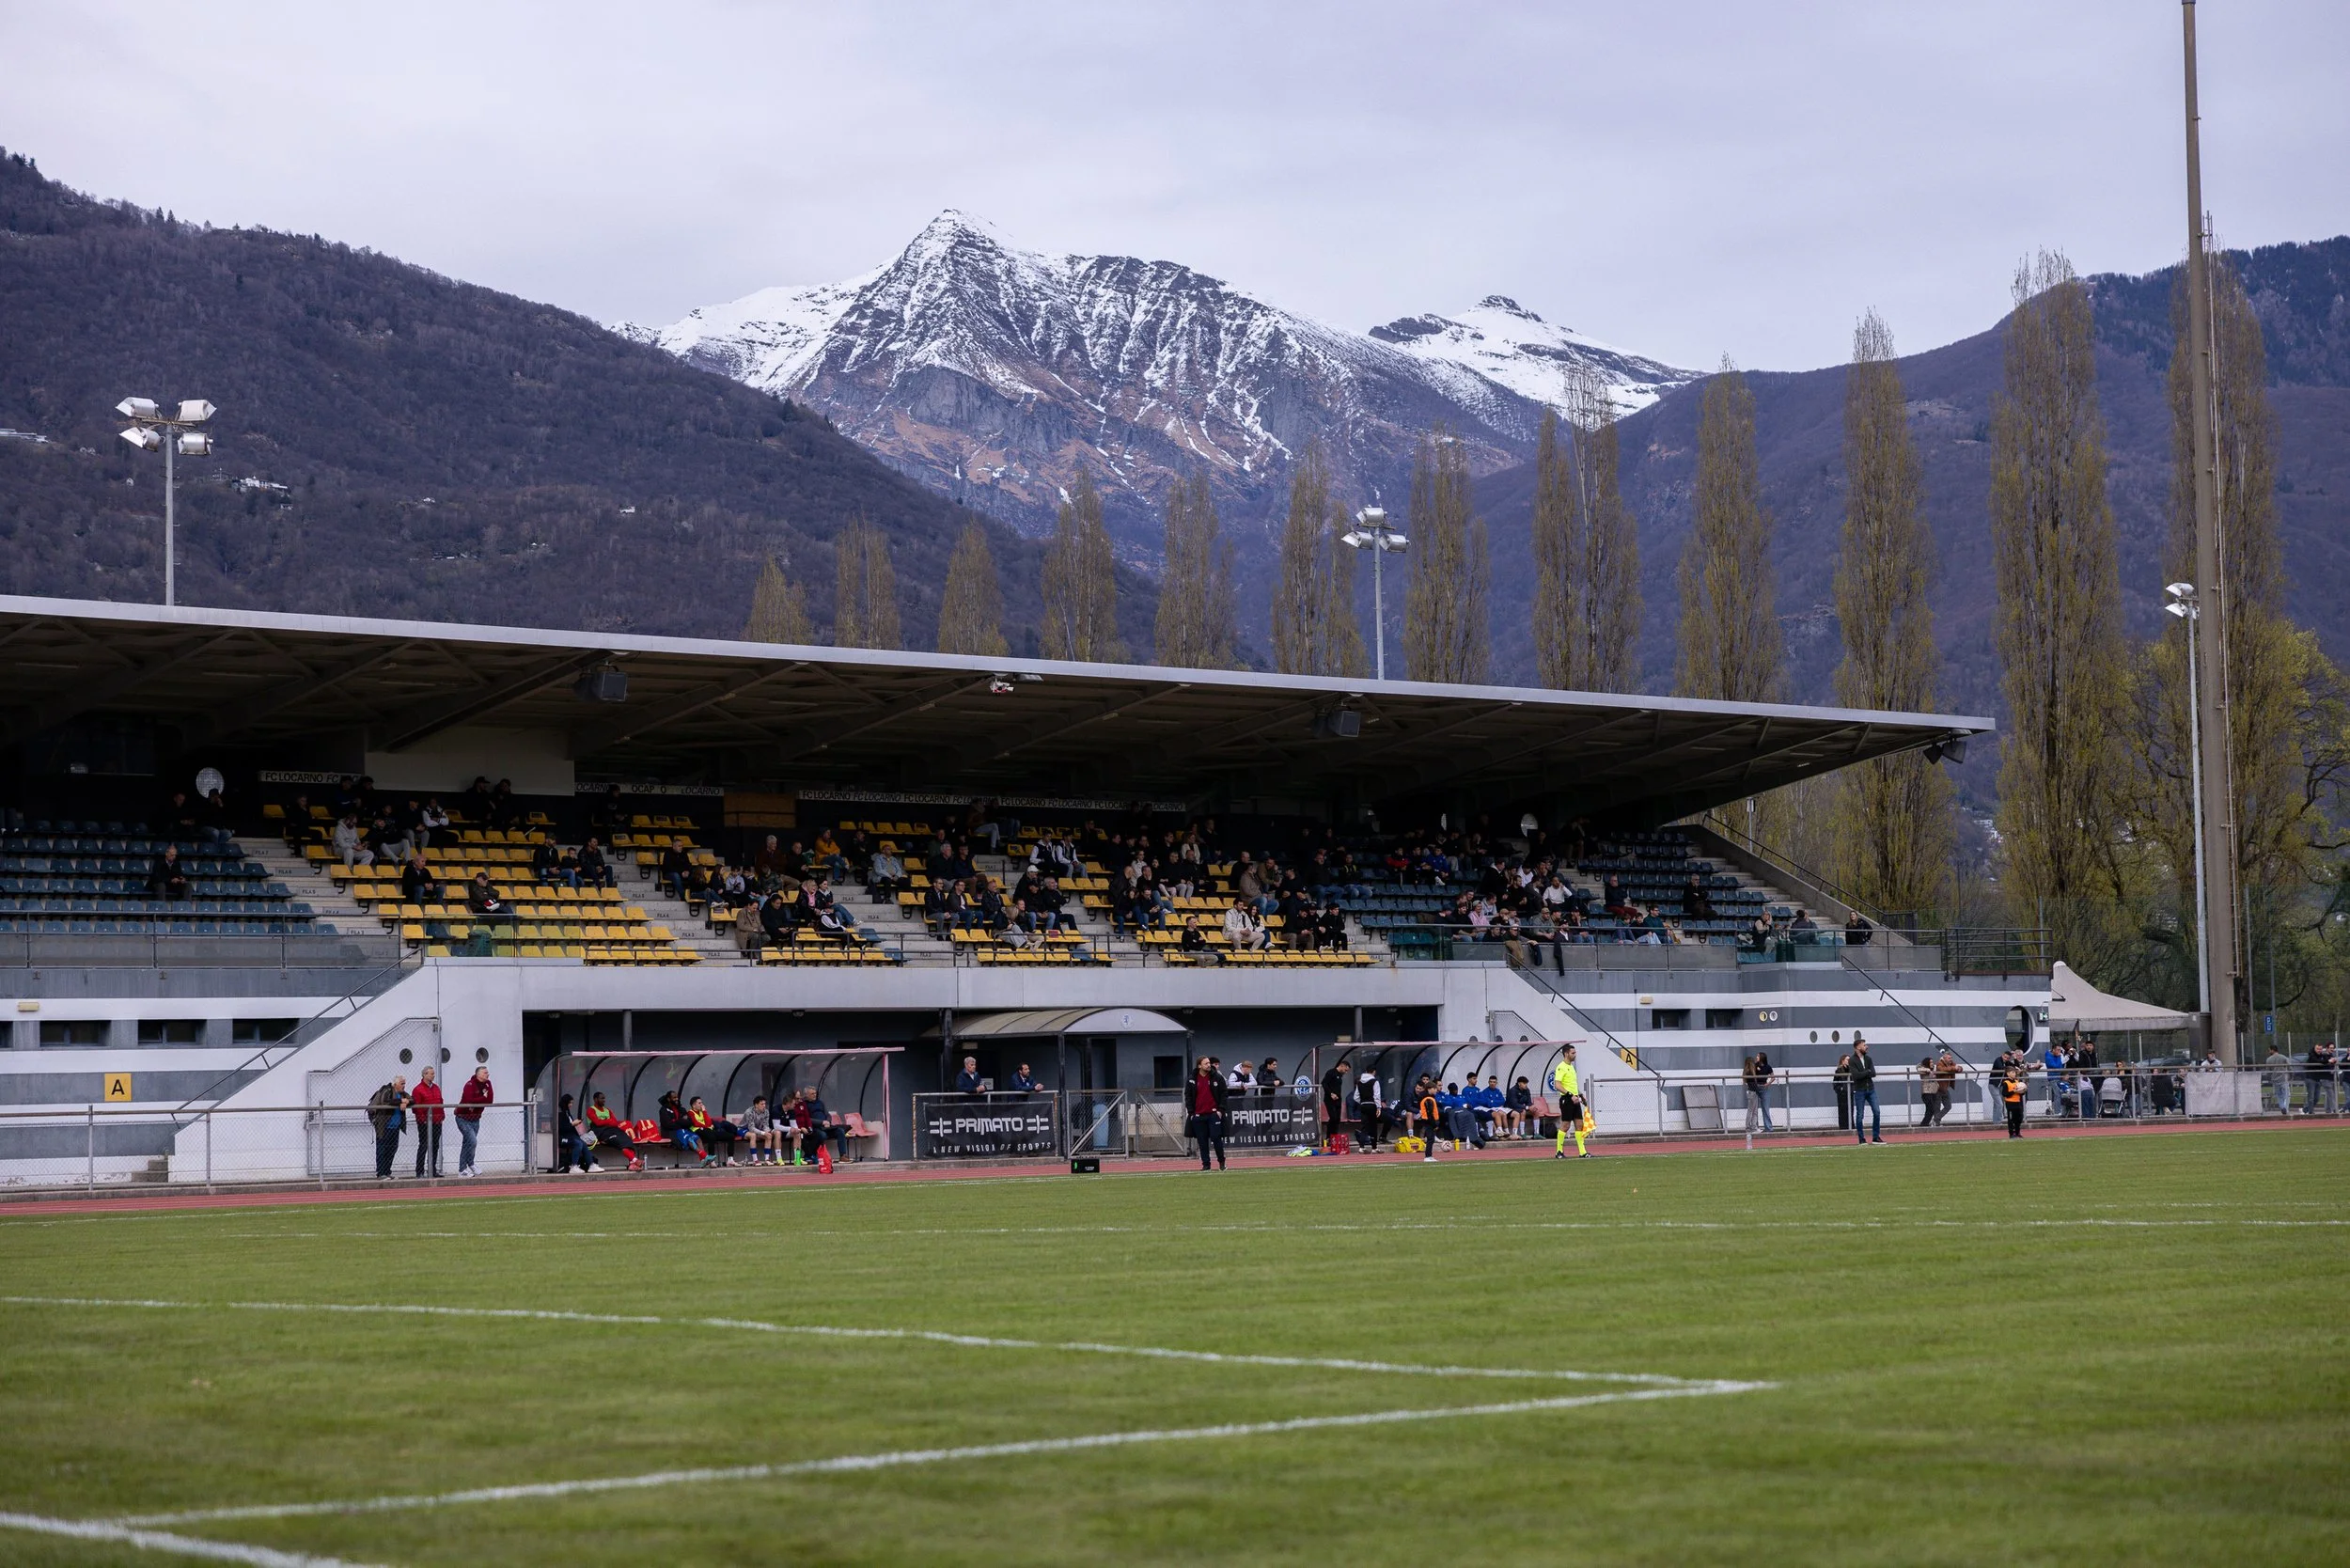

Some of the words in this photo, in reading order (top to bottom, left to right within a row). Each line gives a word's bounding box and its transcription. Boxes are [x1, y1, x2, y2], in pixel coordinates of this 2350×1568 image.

[279, 773, 323, 783] LOCARNO
[814, 792, 851, 800] LOCARNO
[111, 1079, 124, 1095] A
[1232, 1108, 1290, 1126] PRIMATO
[640, 1120, 653, 1131] 11
[956, 1117, 1024, 1136] PRIMATO
[1284, 1132, 1316, 1141] SPORTS
[1017, 1141, 1051, 1152] SPORTS
